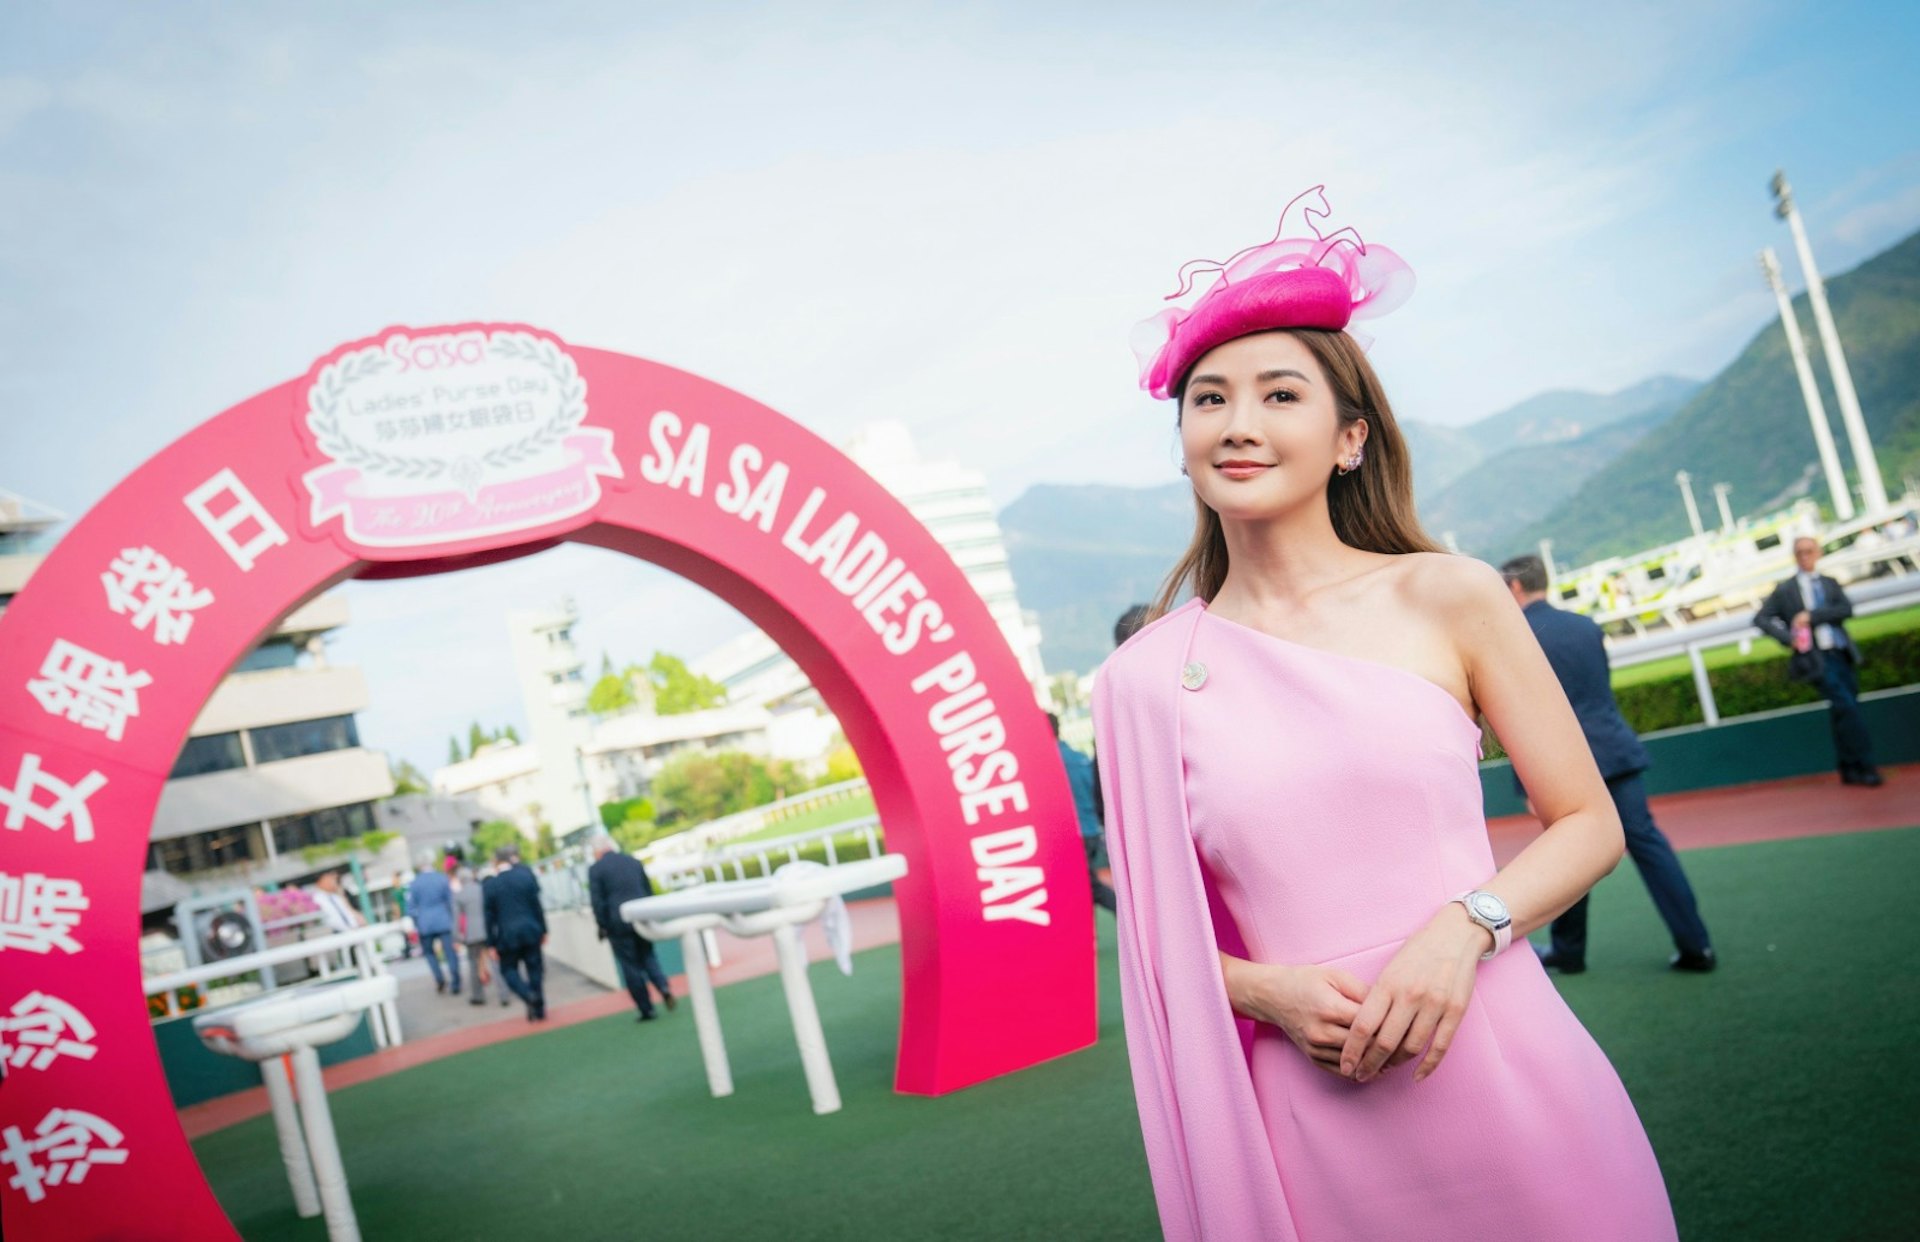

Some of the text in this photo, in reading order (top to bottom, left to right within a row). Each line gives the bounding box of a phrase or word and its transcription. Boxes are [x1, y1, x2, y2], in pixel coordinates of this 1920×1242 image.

[432, 381, 501, 403] Purse
[506, 375, 549, 396] Day
[639, 409, 1050, 926] SA SA LADIES' PURSE DAY
